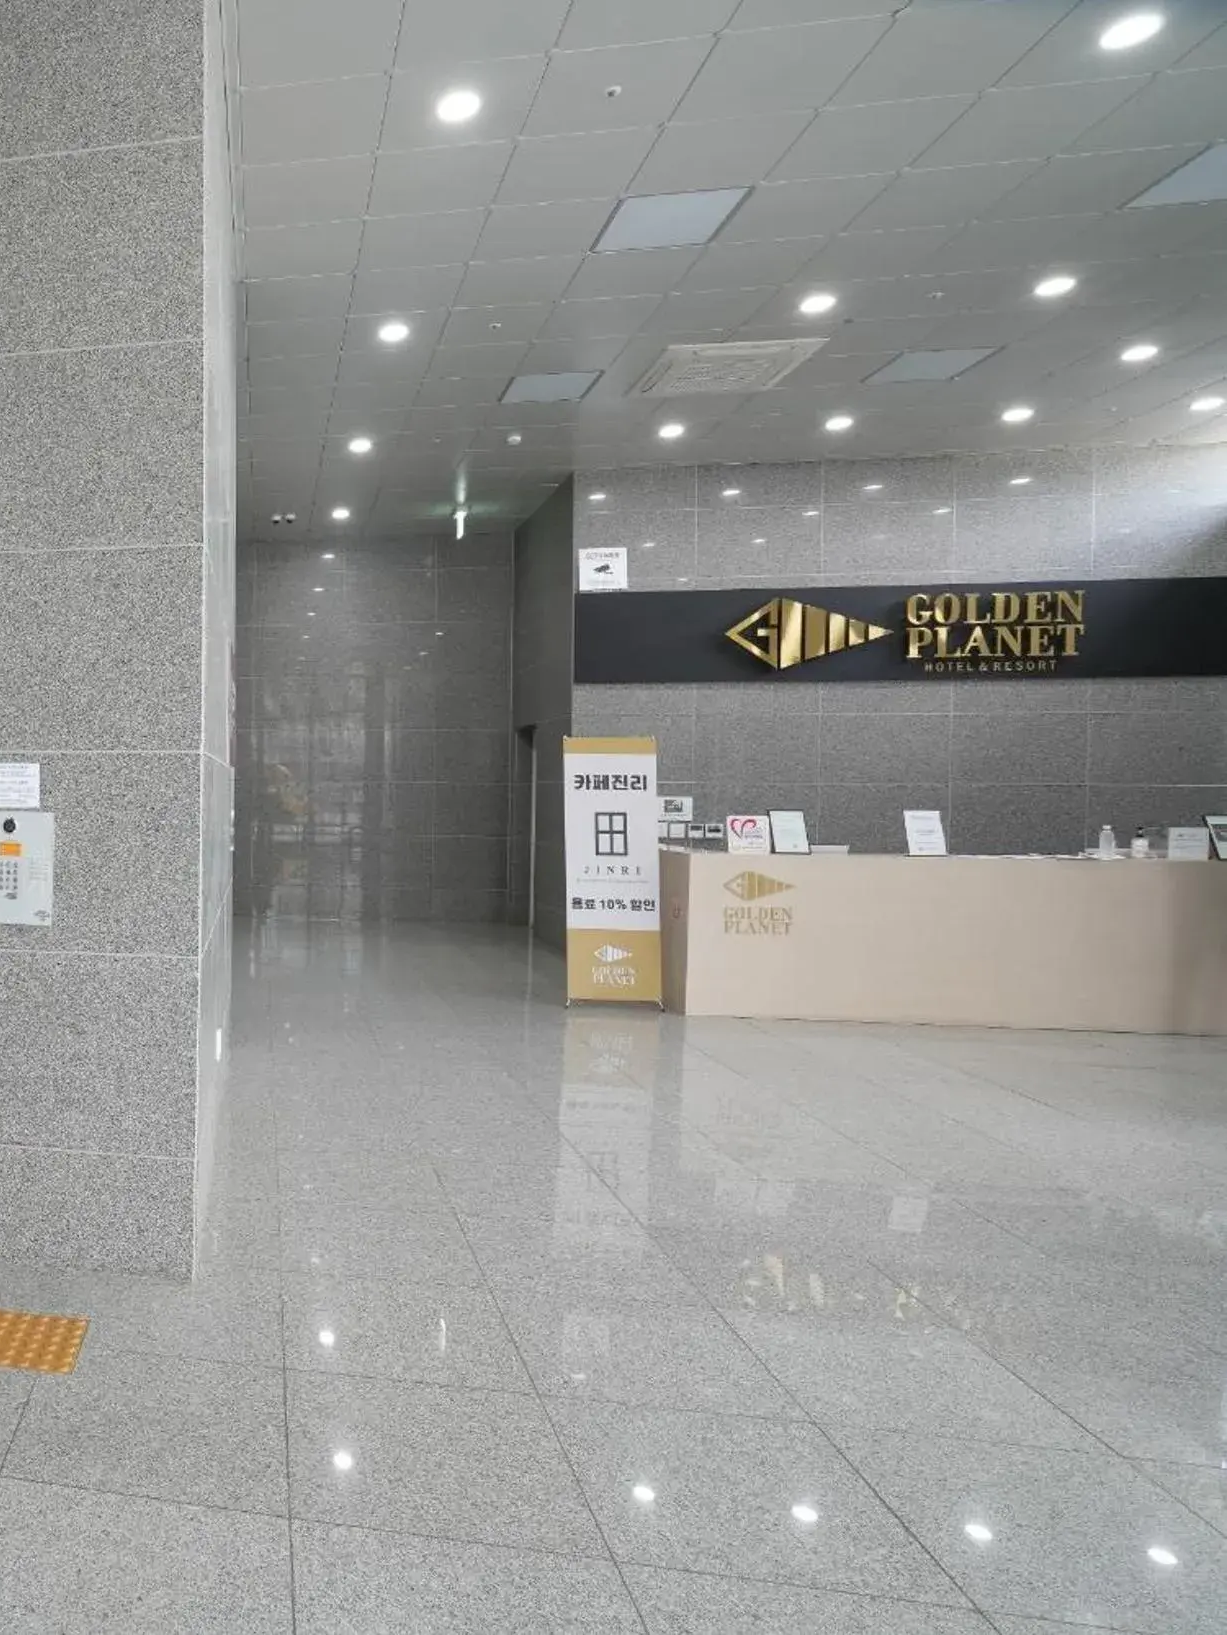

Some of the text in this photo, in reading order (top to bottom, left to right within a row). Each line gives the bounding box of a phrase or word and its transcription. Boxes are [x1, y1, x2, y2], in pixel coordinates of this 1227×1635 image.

[906, 590, 1085, 625] GOLDEN
[906, 624, 1085, 658] PLANET
[925, 659, 1058, 672] HOTEL & RESORT
[574, 774, 648, 791] 카페진리
[599, 899, 627, 910] 10%
[630, 899, 656, 912] 할인
[723, 905, 793, 922] GOLDEN
[723, 920, 793, 936] PLANET
